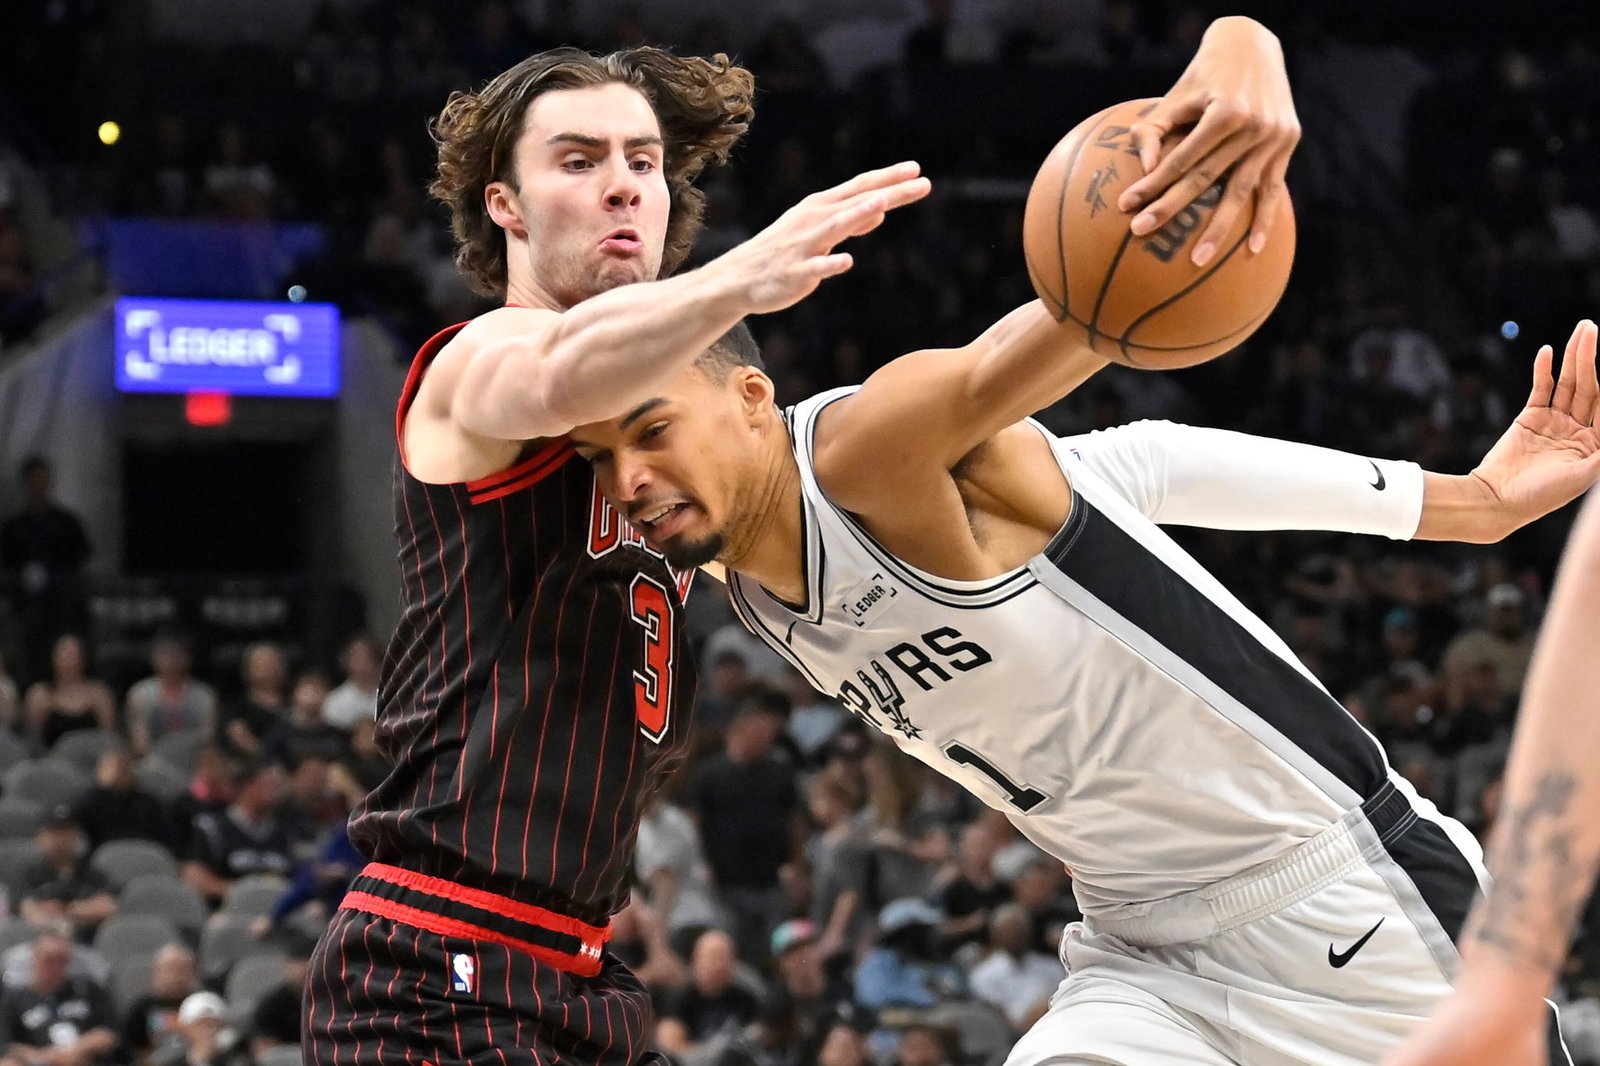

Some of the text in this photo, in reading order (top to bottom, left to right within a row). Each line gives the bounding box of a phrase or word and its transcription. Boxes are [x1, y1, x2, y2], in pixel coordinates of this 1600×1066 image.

[148, 326, 278, 367] LEDGER
[851, 585, 886, 618] LEDGER
[629, 571, 674, 745] 3
[941, 740, 1052, 815] 1
